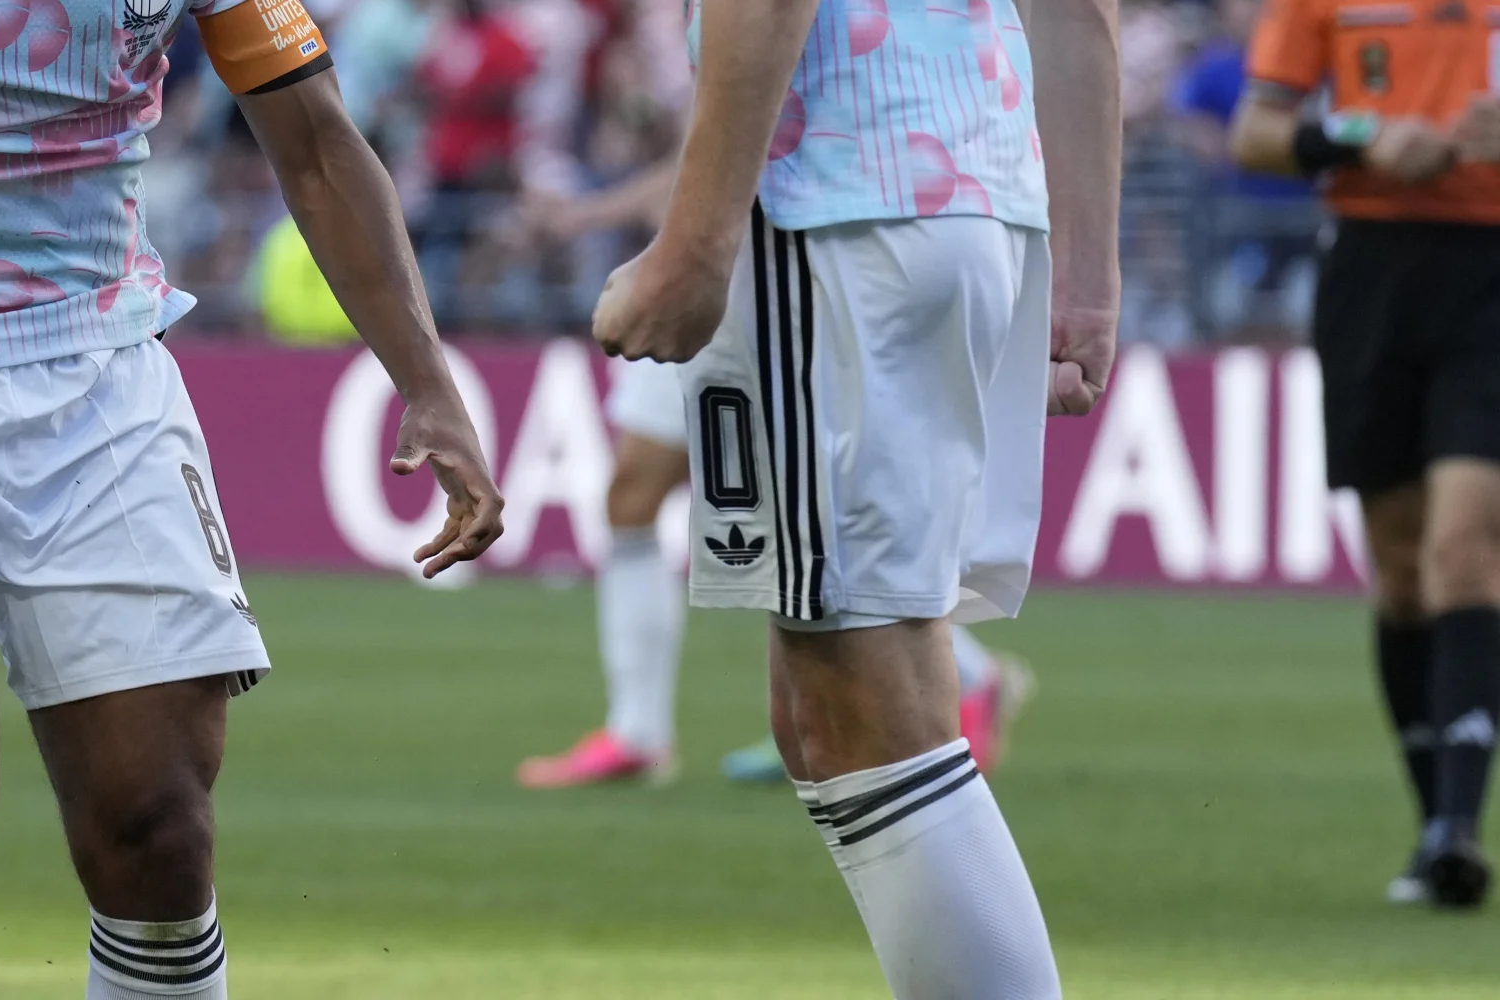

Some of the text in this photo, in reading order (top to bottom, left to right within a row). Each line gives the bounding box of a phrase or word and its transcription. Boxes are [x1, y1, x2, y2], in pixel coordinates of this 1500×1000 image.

[270, 31, 296, 51] the
[300, 40, 318, 55] FIFA
[181, 463, 232, 578] 8
